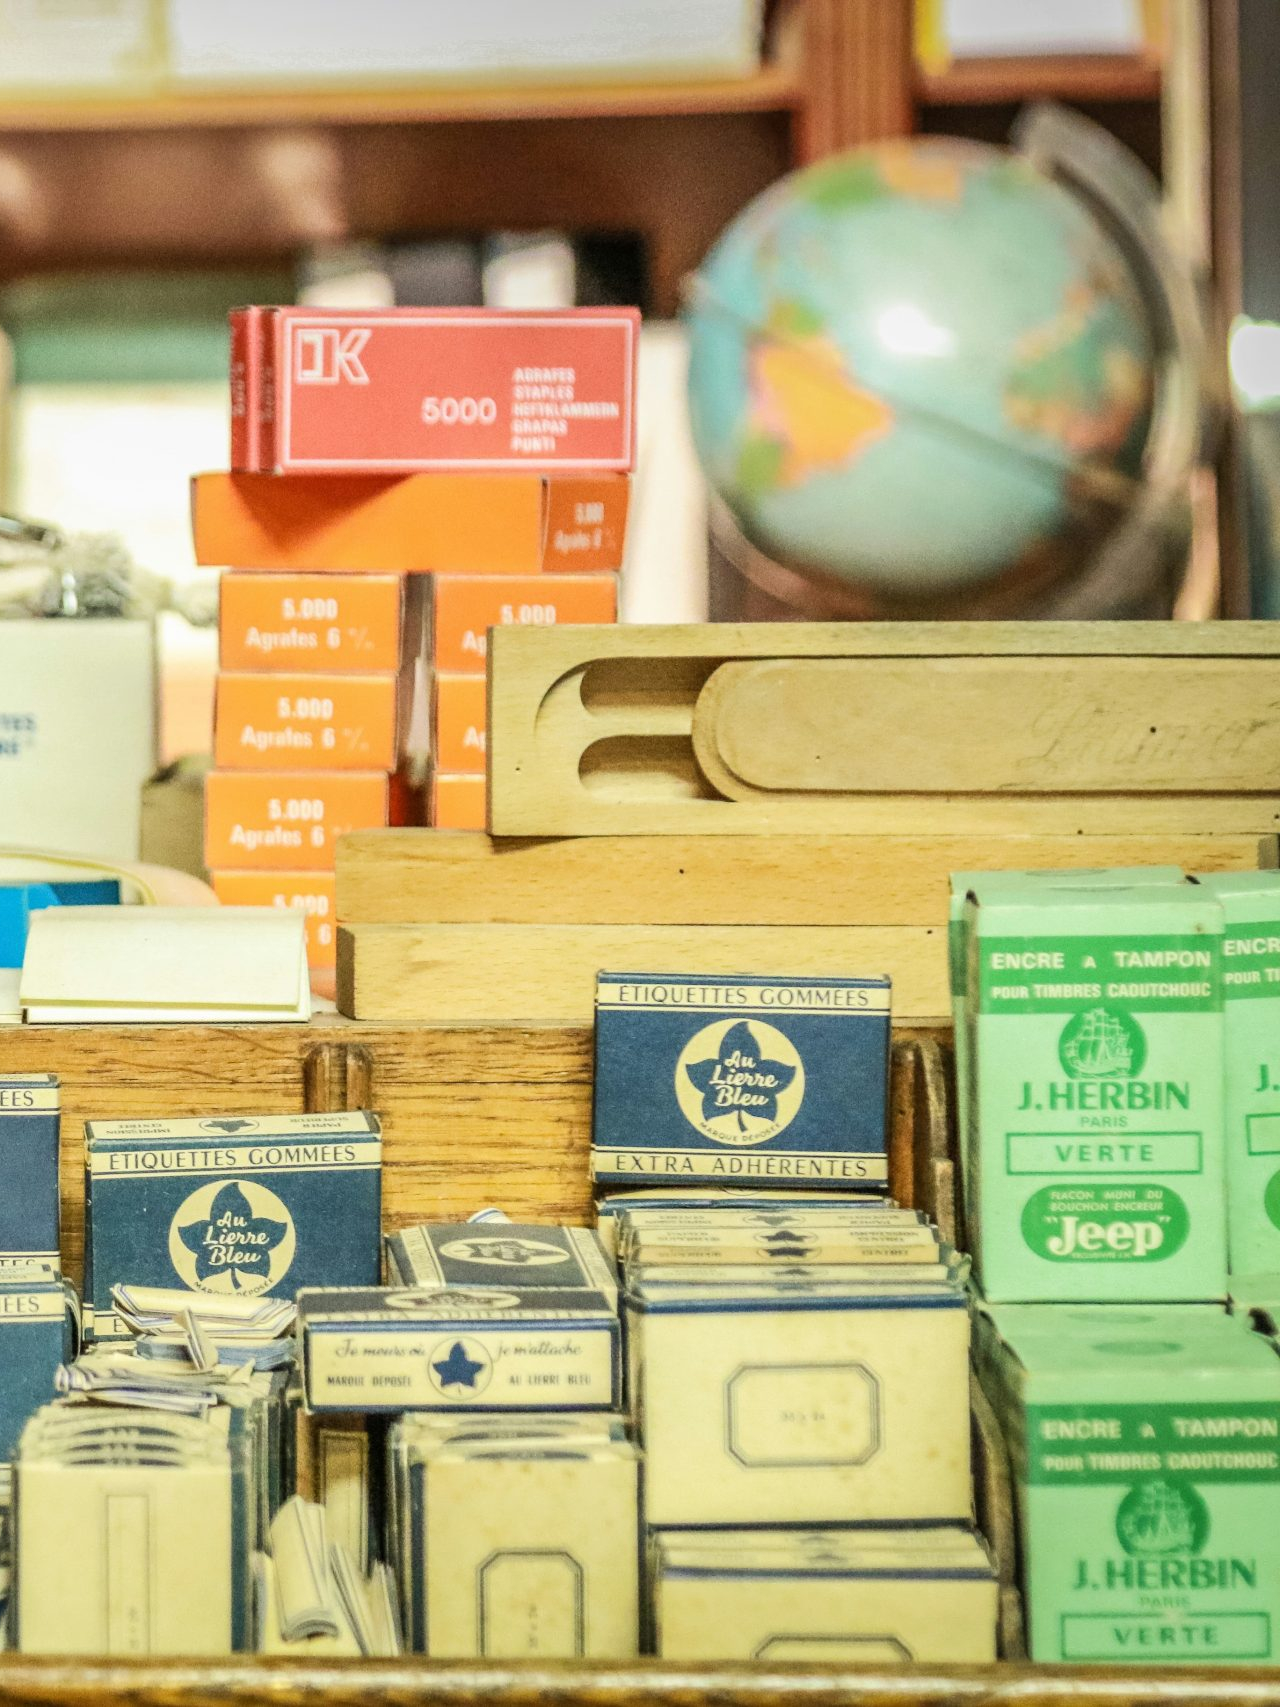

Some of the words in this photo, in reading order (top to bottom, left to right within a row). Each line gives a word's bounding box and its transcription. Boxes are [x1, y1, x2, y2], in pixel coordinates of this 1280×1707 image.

[514, 367, 576, 383] AGRAFES
[513, 385, 574, 400] STAPLES
[421, 397, 497, 425] 5000
[512, 419, 568, 435] GRAPAS
[510, 436, 556, 452] PUNTI
[282, 598, 338, 620] 5.000
[500, 604, 556, 624] 5.000
[246, 627, 318, 653] Agrafes
[327, 627, 340, 648] 6
[278, 696, 334, 720] 5.000
[241, 725, 312, 752] Agrafes
[322, 728, 335, 748] 6
[268, 800, 324, 820] 5.000
[230, 825, 301, 848] Agrafes
[312, 828, 324, 846] 6
[990, 952, 1065, 970] ENCRE
[1114, 951, 1211, 968] TAMPON
[1225, 971, 1260, 984] POUR
[760, 988, 869, 1006] GOMMÉES
[992, 986, 1028, 999] POUR
[1034, 984, 1101, 998] TIMBRES
[1108, 983, 1211, 998] CAOUTCHOUC
[725, 1050, 756, 1068] Au
[708, 1066, 778, 1088] Lierre
[714, 1085, 768, 1107] Bleu
[1018, 1081, 1190, 1111] J.HERBIN
[1080, 1116, 1128, 1128] PARIS
[700, 1122, 738, 1142] MARQUE
[249, 1145, 356, 1165] GOMMÉES
[1055, 1145, 1154, 1163] VERTE
[616, 1156, 694, 1173] EXTRA
[713, 1156, 867, 1176] ADHÉRENTES
[1051, 1191, 1094, 1200] FLACON
[1104, 1190, 1136, 1200] MUNI
[1146, 1190, 1163, 1199] DU
[1050, 1202, 1108, 1211] BOUCHON
[217, 1211, 248, 1228] Au
[202, 1226, 270, 1246] Lierre
[208, 1245, 260, 1266] Bleu
[327, 1376, 364, 1386] MARQUE
[510, 1375, 522, 1385] AU
[528, 1375, 559, 1385] LIERRE
[568, 1375, 590, 1385] BLEU
[1041, 1420, 1121, 1439] ENCRE
[1173, 1418, 1278, 1437] TAMPON
[1045, 1455, 1084, 1471] POUR
[1088, 1454, 1161, 1470] TIMBRES
[1168, 1452, 1278, 1468] CAOUTCHOUC
[1074, 1559, 1256, 1589] J.HERBIN
[1138, 1596, 1190, 1607] PARIS
[1113, 1626, 1219, 1645] VERTE
